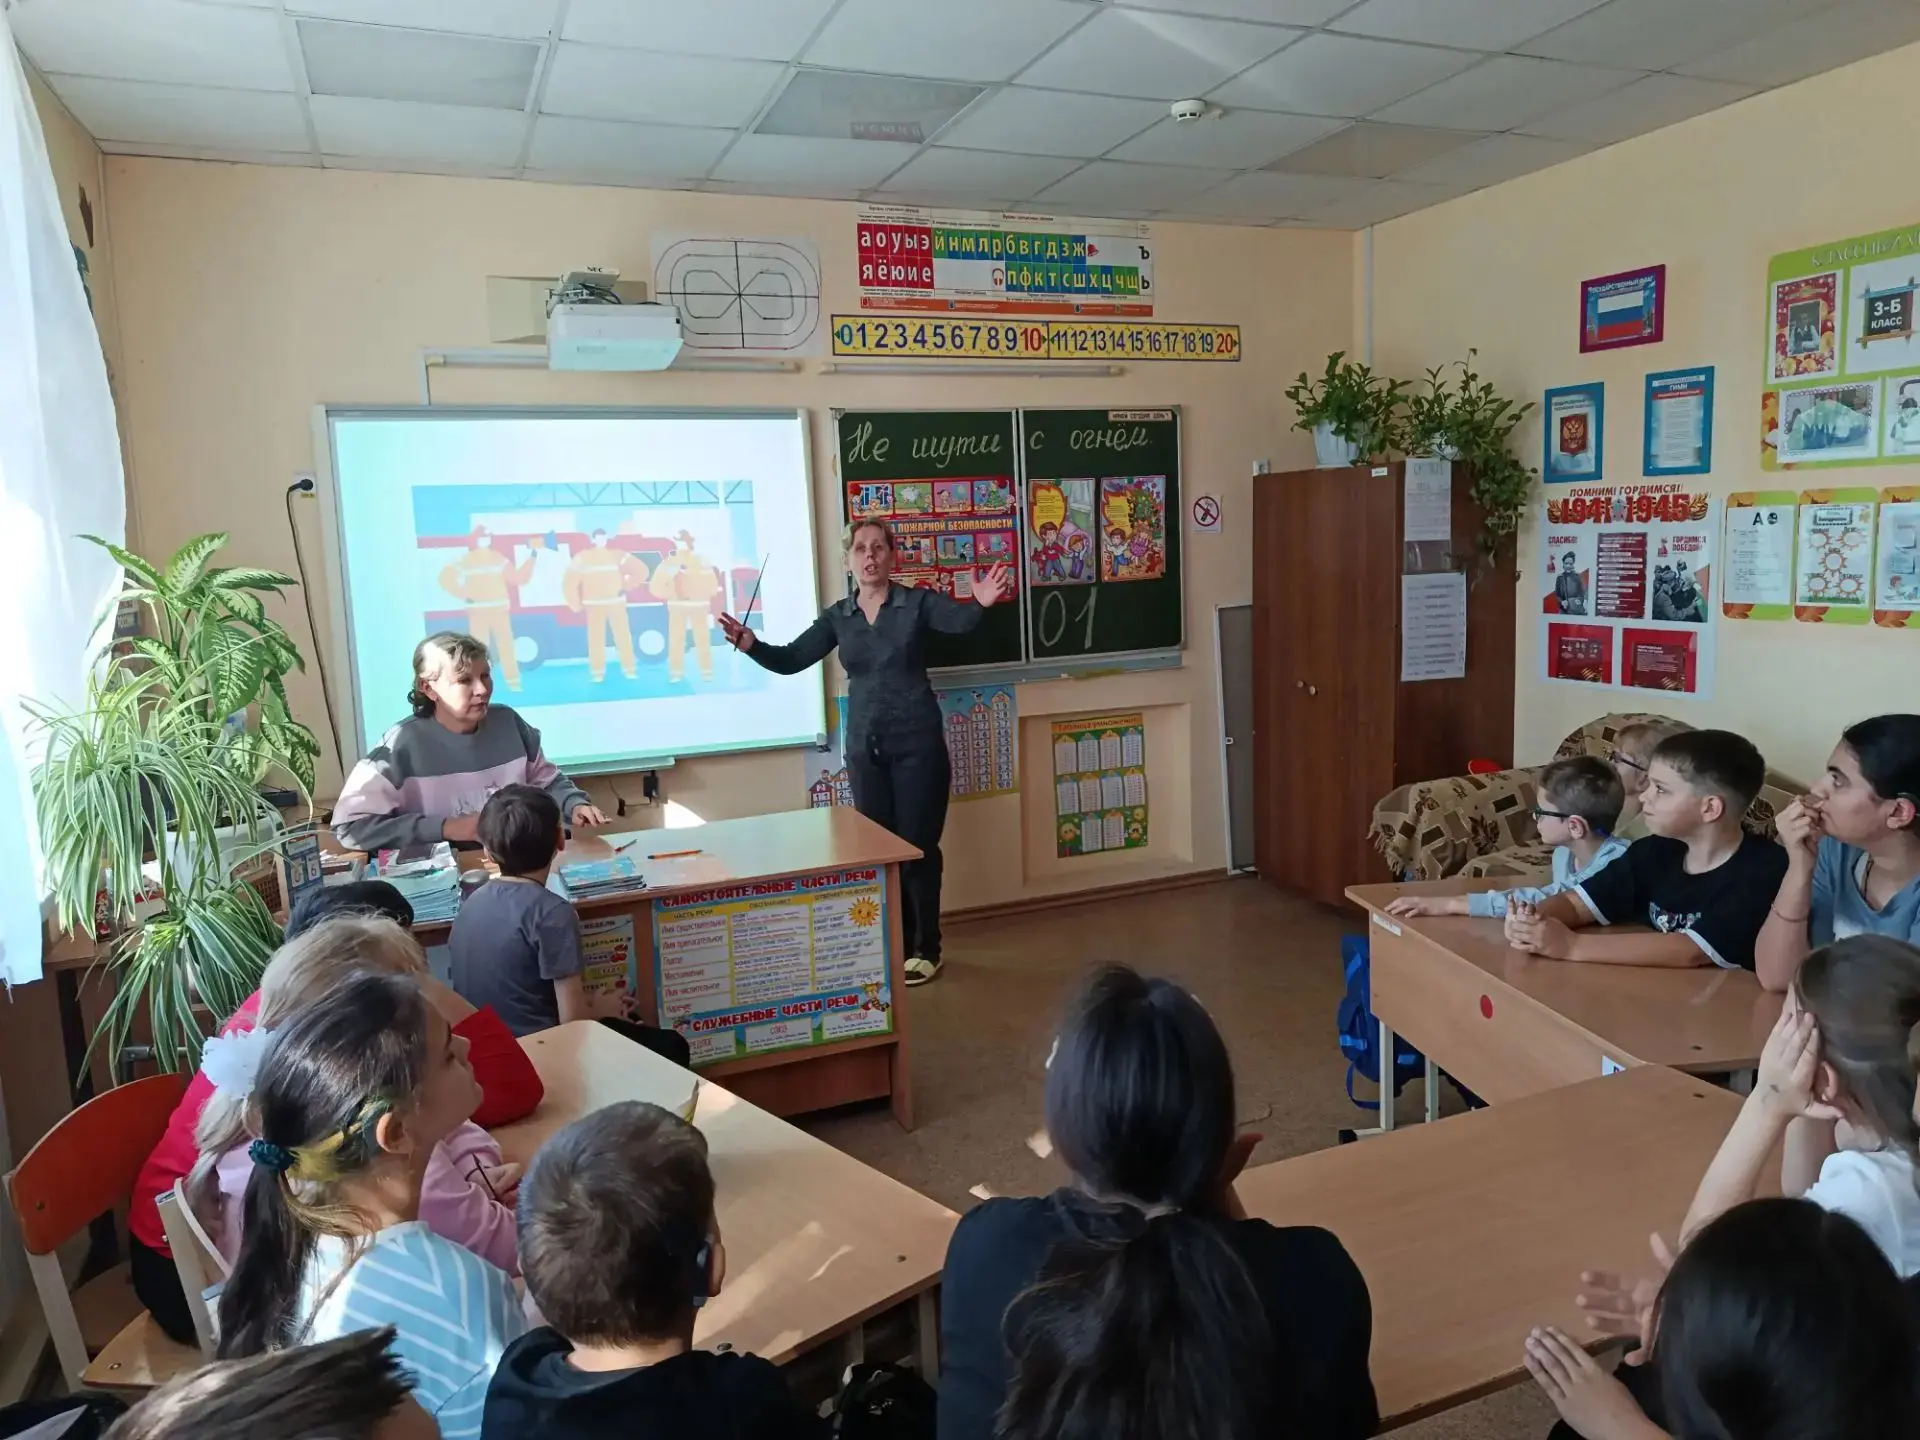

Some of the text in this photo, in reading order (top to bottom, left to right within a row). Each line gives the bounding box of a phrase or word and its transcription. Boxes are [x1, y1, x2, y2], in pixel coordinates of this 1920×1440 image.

[1874, 299, 1901, 316] 3-Б
[1871, 317, 1903, 329] КЛАСС
[840, 323, 1233, 353] 0 1 2 3 4 5 6 7 8 9 10 11 12 13 14 15 16 17 18 19 20
[846, 421, 889, 463] Не
[912, 431, 1002, 468] шути
[1030, 430, 1044, 450] с
[1619, 483, 1681, 496] ГОРДИМСЯ!
[1625, 494, 1690, 523] 1945
[898, 519, 946, 533] ПОЖАРНОЙ
[948, 518, 1013, 531] БЕЗОПАСНОСТИ
[1038, 587, 1098, 650] 01
[662, 869, 877, 908] САМОСТОЯТЕЛЬНЫЕ ЧАСТИ РЕЧИ
[692, 994, 859, 1032] СЛУЖЕБНЫЕ ЧАСТИ РЕЧИ
